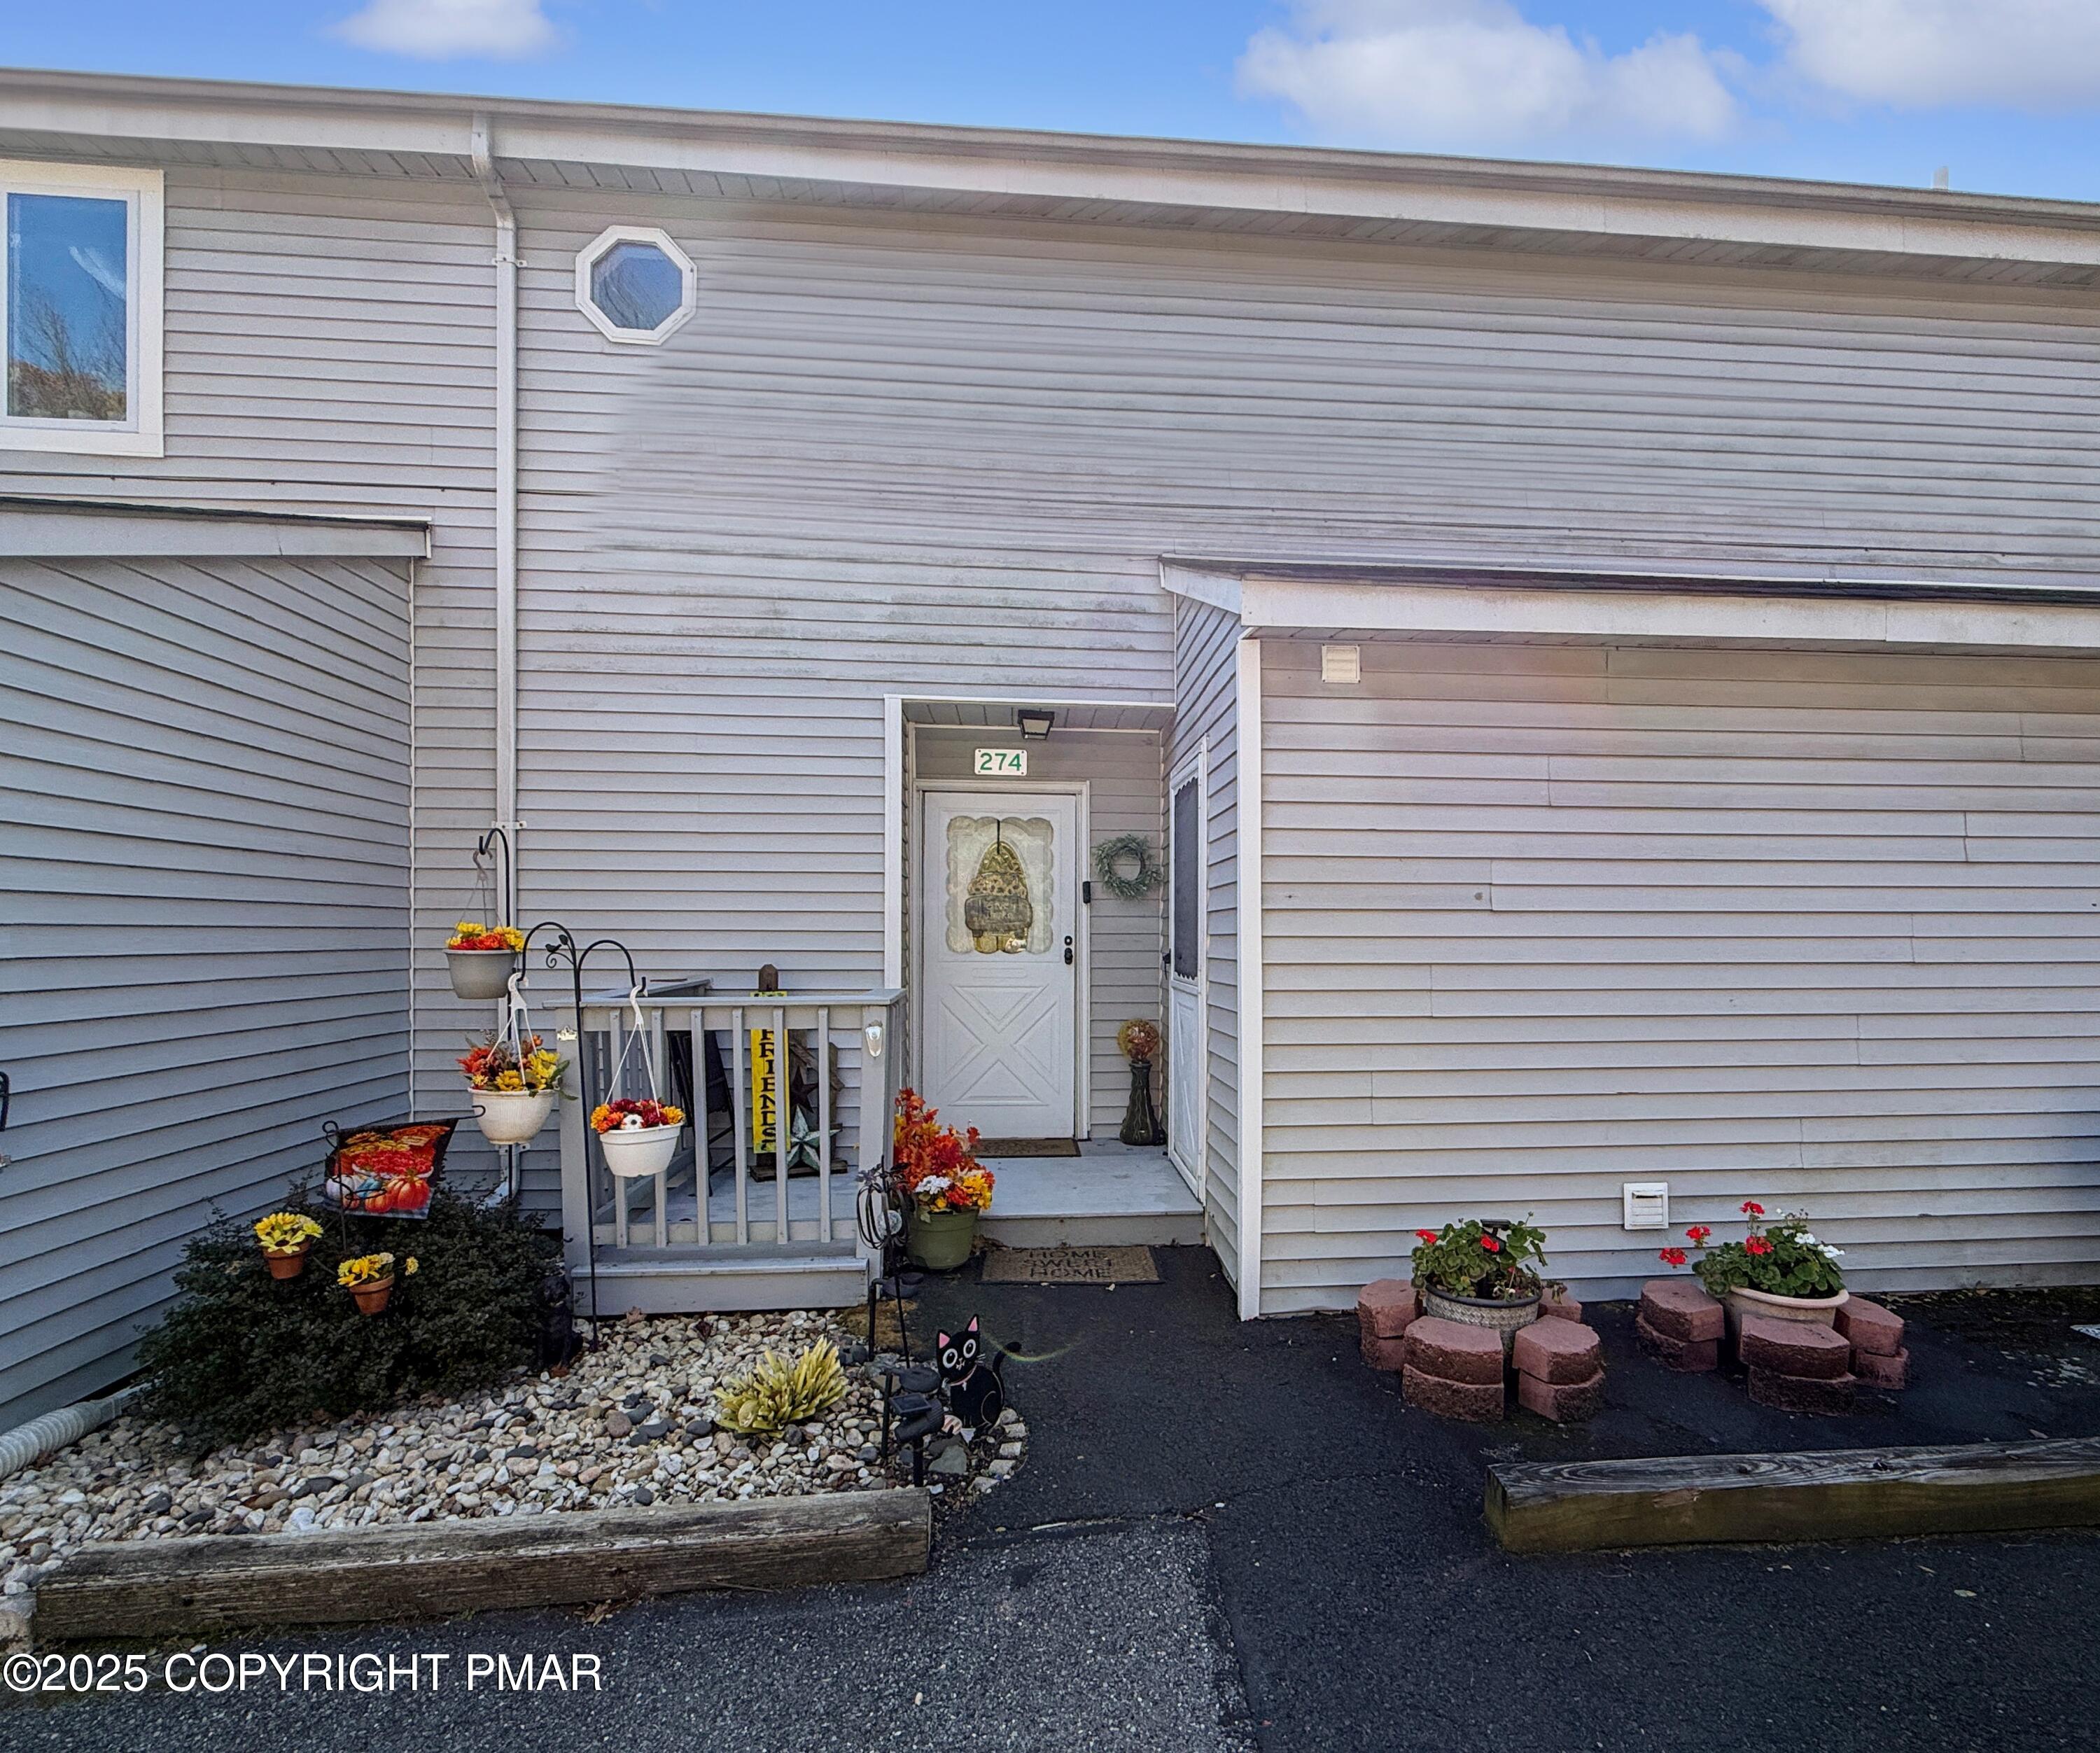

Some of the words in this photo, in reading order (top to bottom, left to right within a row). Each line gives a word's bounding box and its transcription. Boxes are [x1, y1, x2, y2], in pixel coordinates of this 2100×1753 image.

[980, 753, 1022, 771] 274
[1029, 1250, 1108, 1259] HOME
[1023, 1259, 1112, 1268] SWEET
[1030, 1268, 1110, 1278] HOME
